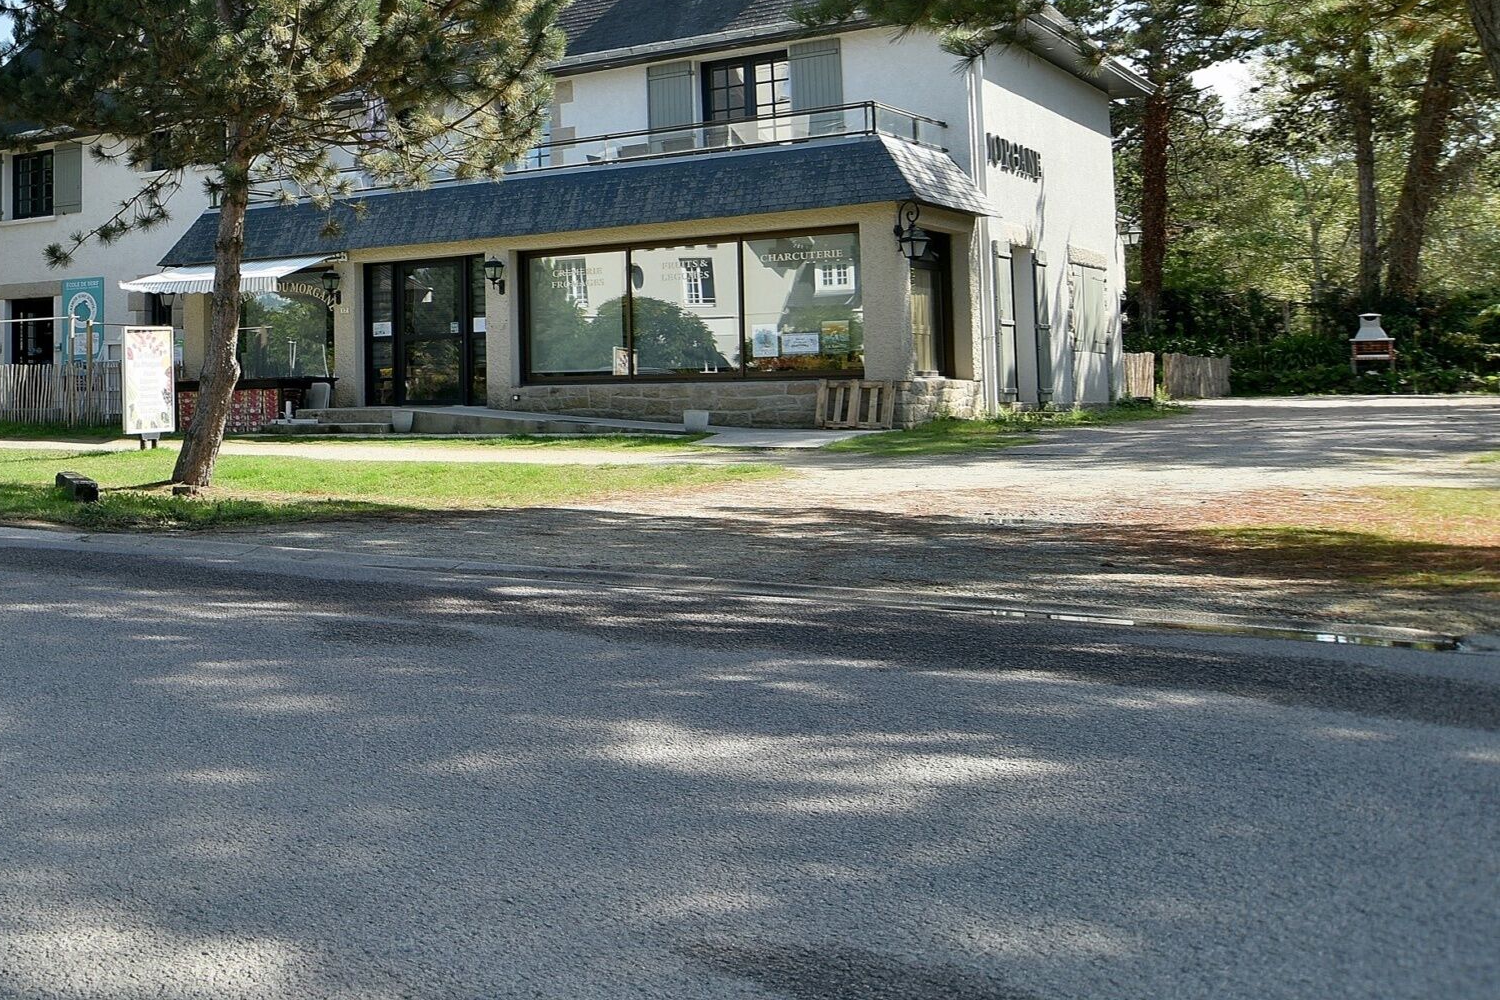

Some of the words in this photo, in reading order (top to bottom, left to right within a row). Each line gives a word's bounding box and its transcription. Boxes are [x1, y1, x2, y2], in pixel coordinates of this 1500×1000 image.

[760, 249, 844, 262] CHARCUTERIE
[662, 260, 698, 269] FRUITS
[700, 259, 708, 267] &
[551, 279, 604, 289] FROMAGES
